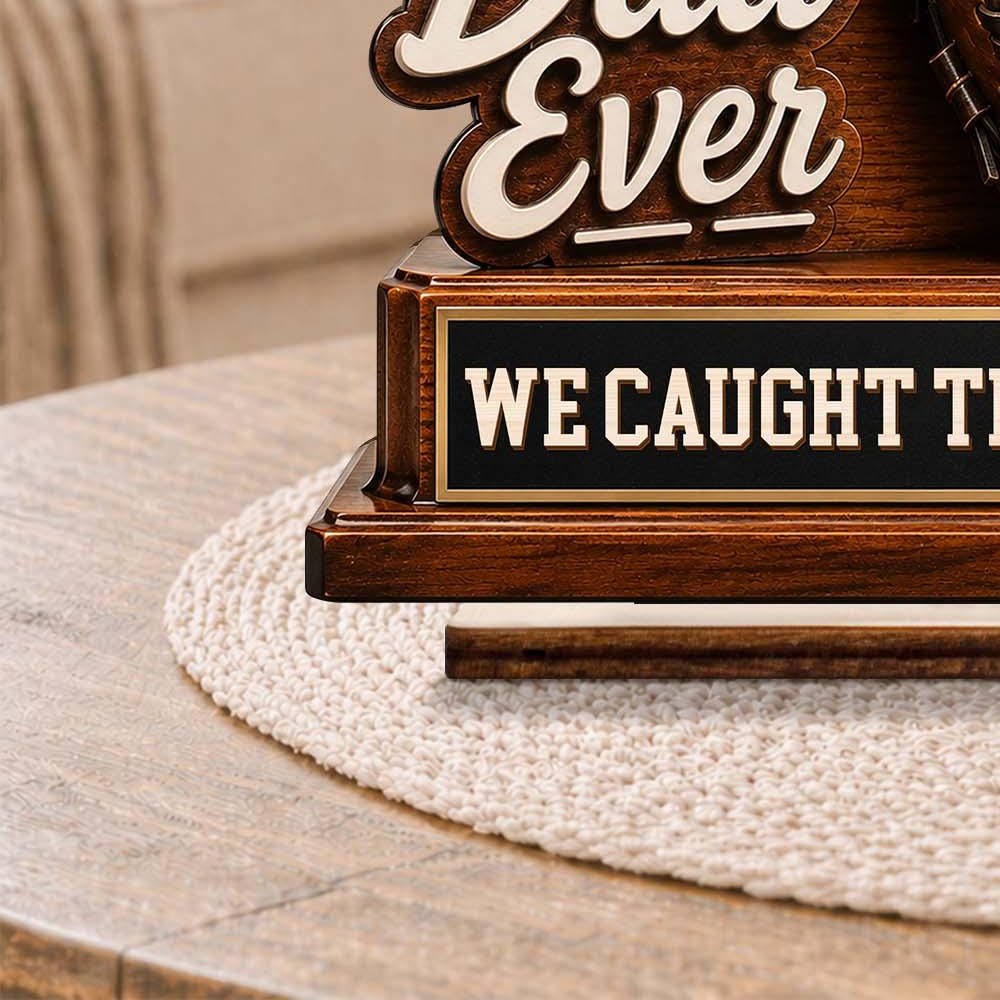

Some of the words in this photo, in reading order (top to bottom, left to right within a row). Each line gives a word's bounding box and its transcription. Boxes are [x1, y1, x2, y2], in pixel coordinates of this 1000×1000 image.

[460, 36, 845, 241] Ever
[464, 367, 589, 451] WE
[604, 367, 918, 451] CAUGHT
